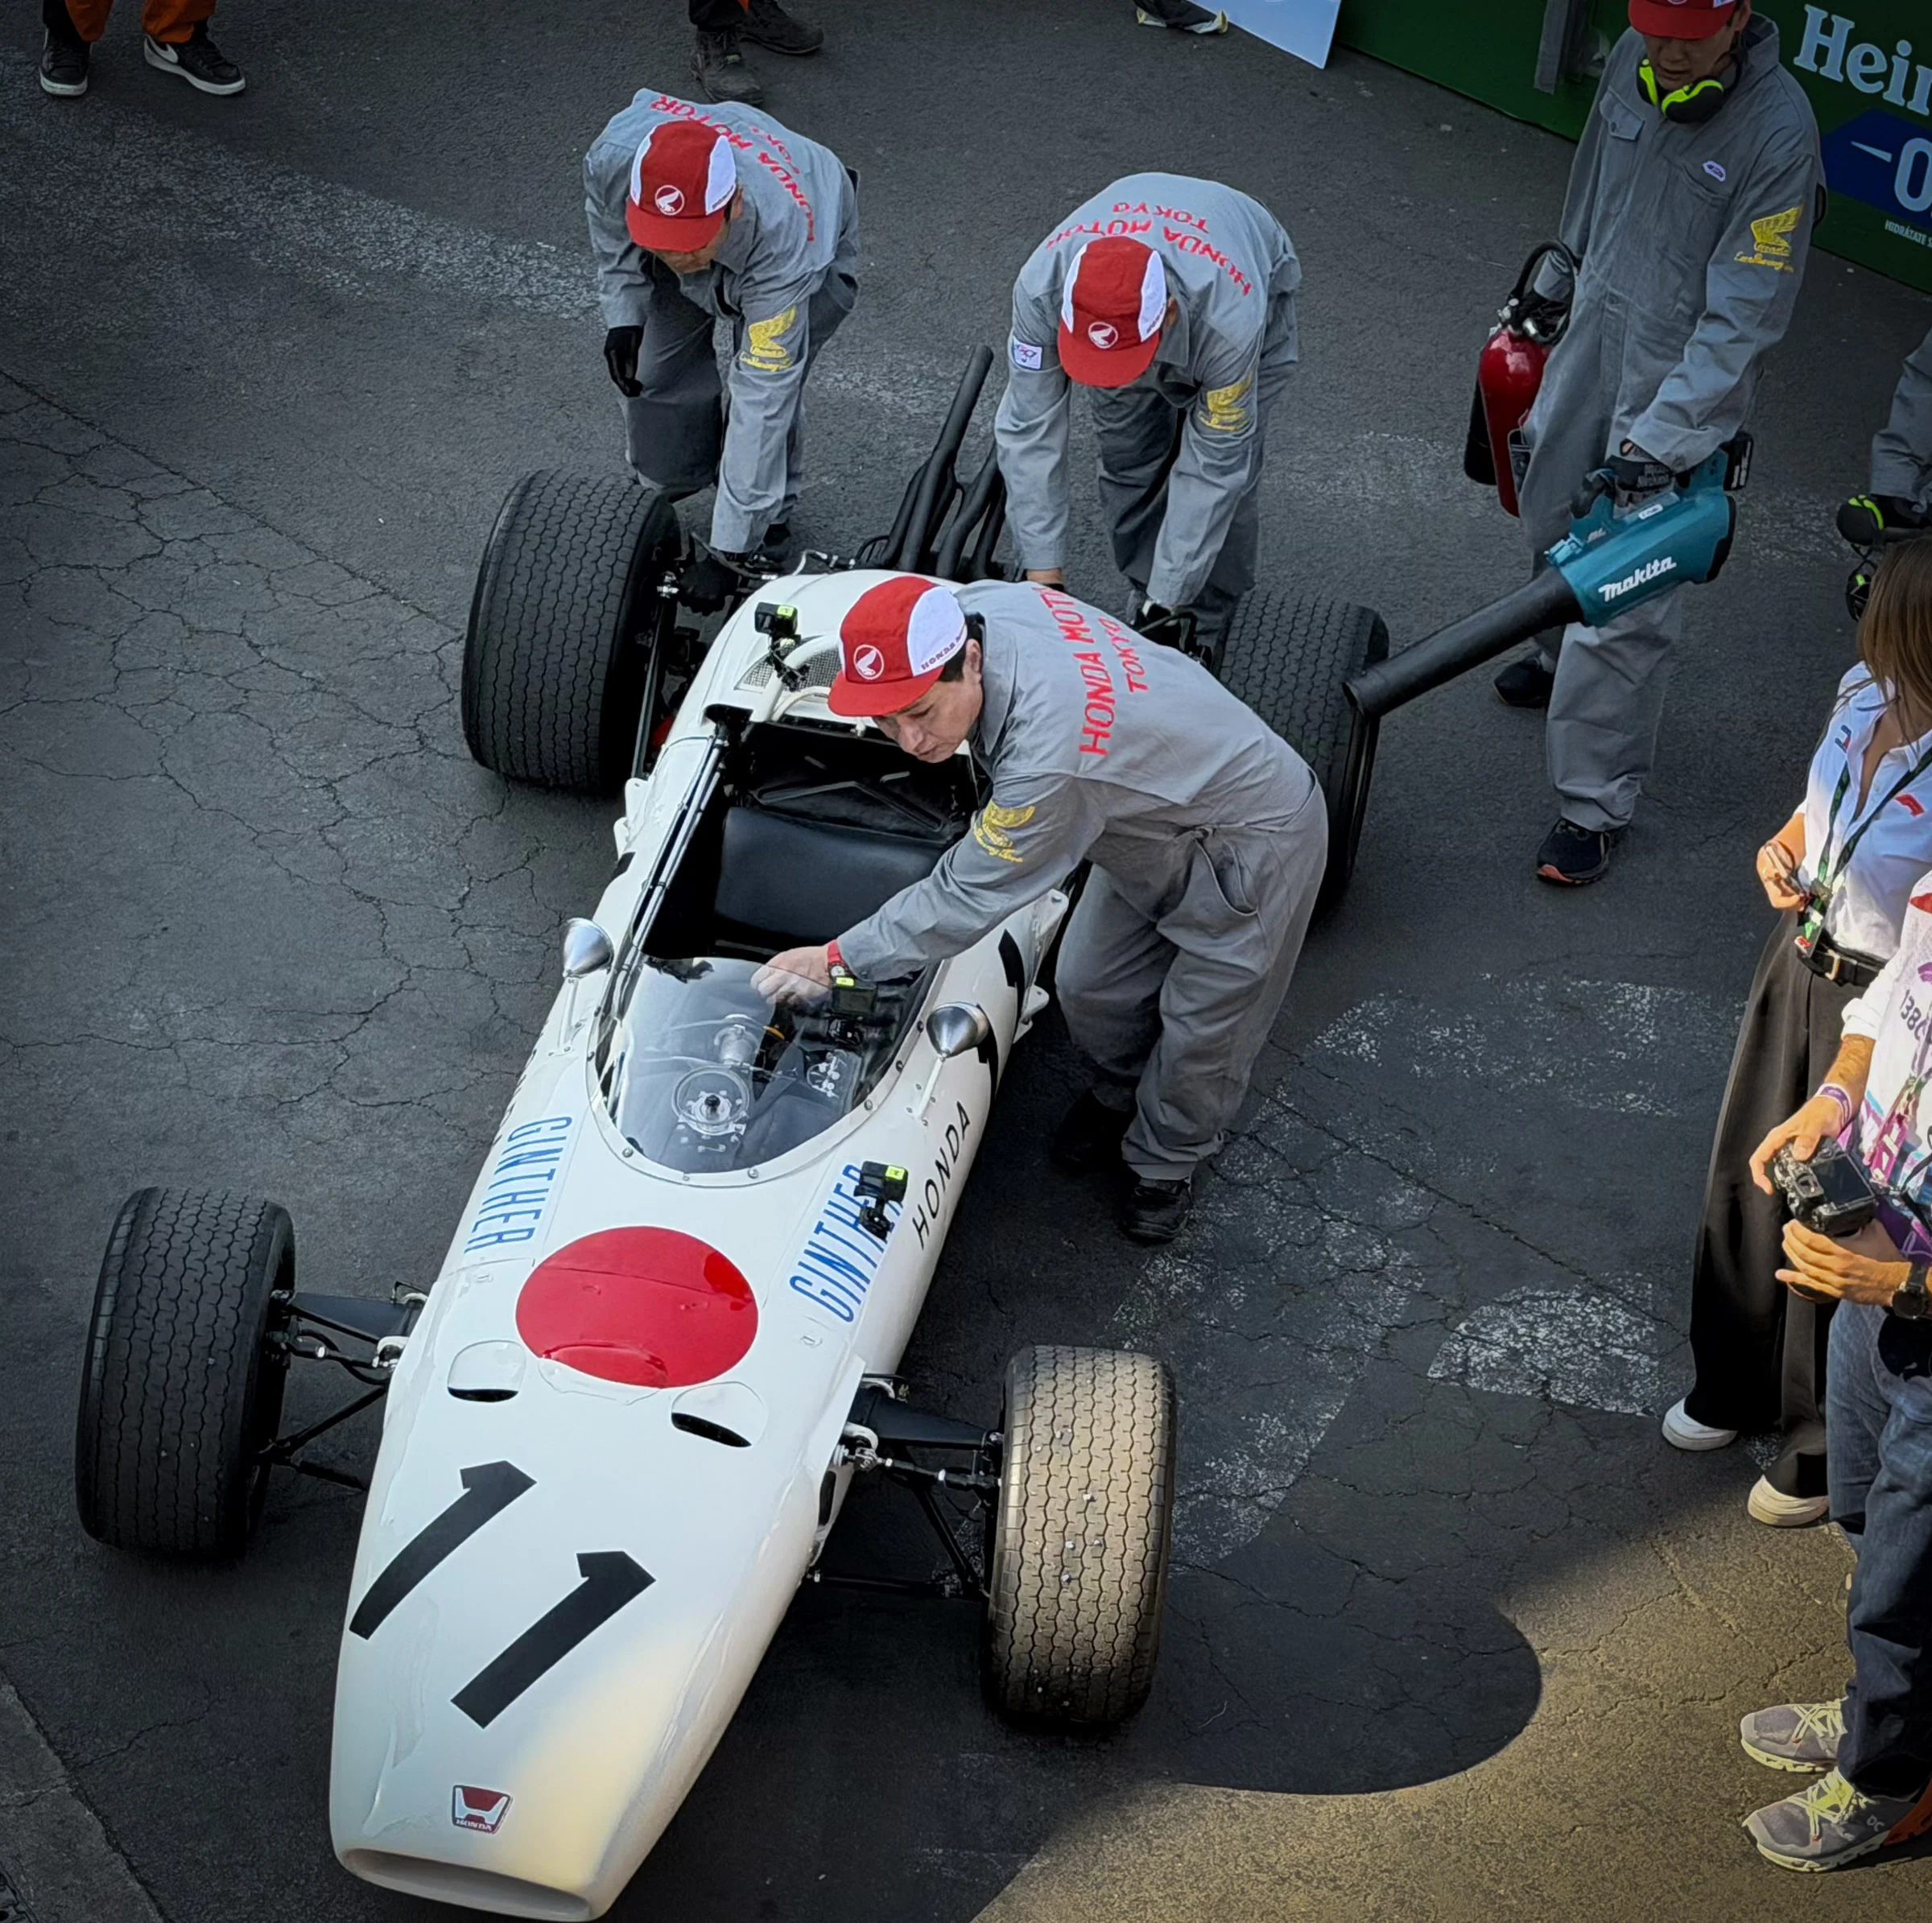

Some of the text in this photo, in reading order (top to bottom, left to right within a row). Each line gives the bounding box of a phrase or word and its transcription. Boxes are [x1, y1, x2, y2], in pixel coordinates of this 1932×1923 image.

[1113, 202, 1209, 233] TOKYO
[1163, 226, 1253, 296] HONDA
[1031, 587, 1116, 755] HONDA MOTO
[1098, 617, 1149, 692] TOKYO
[464, 1116, 572, 1254] GINTHER
[911, 1101, 971, 1250] HONDA
